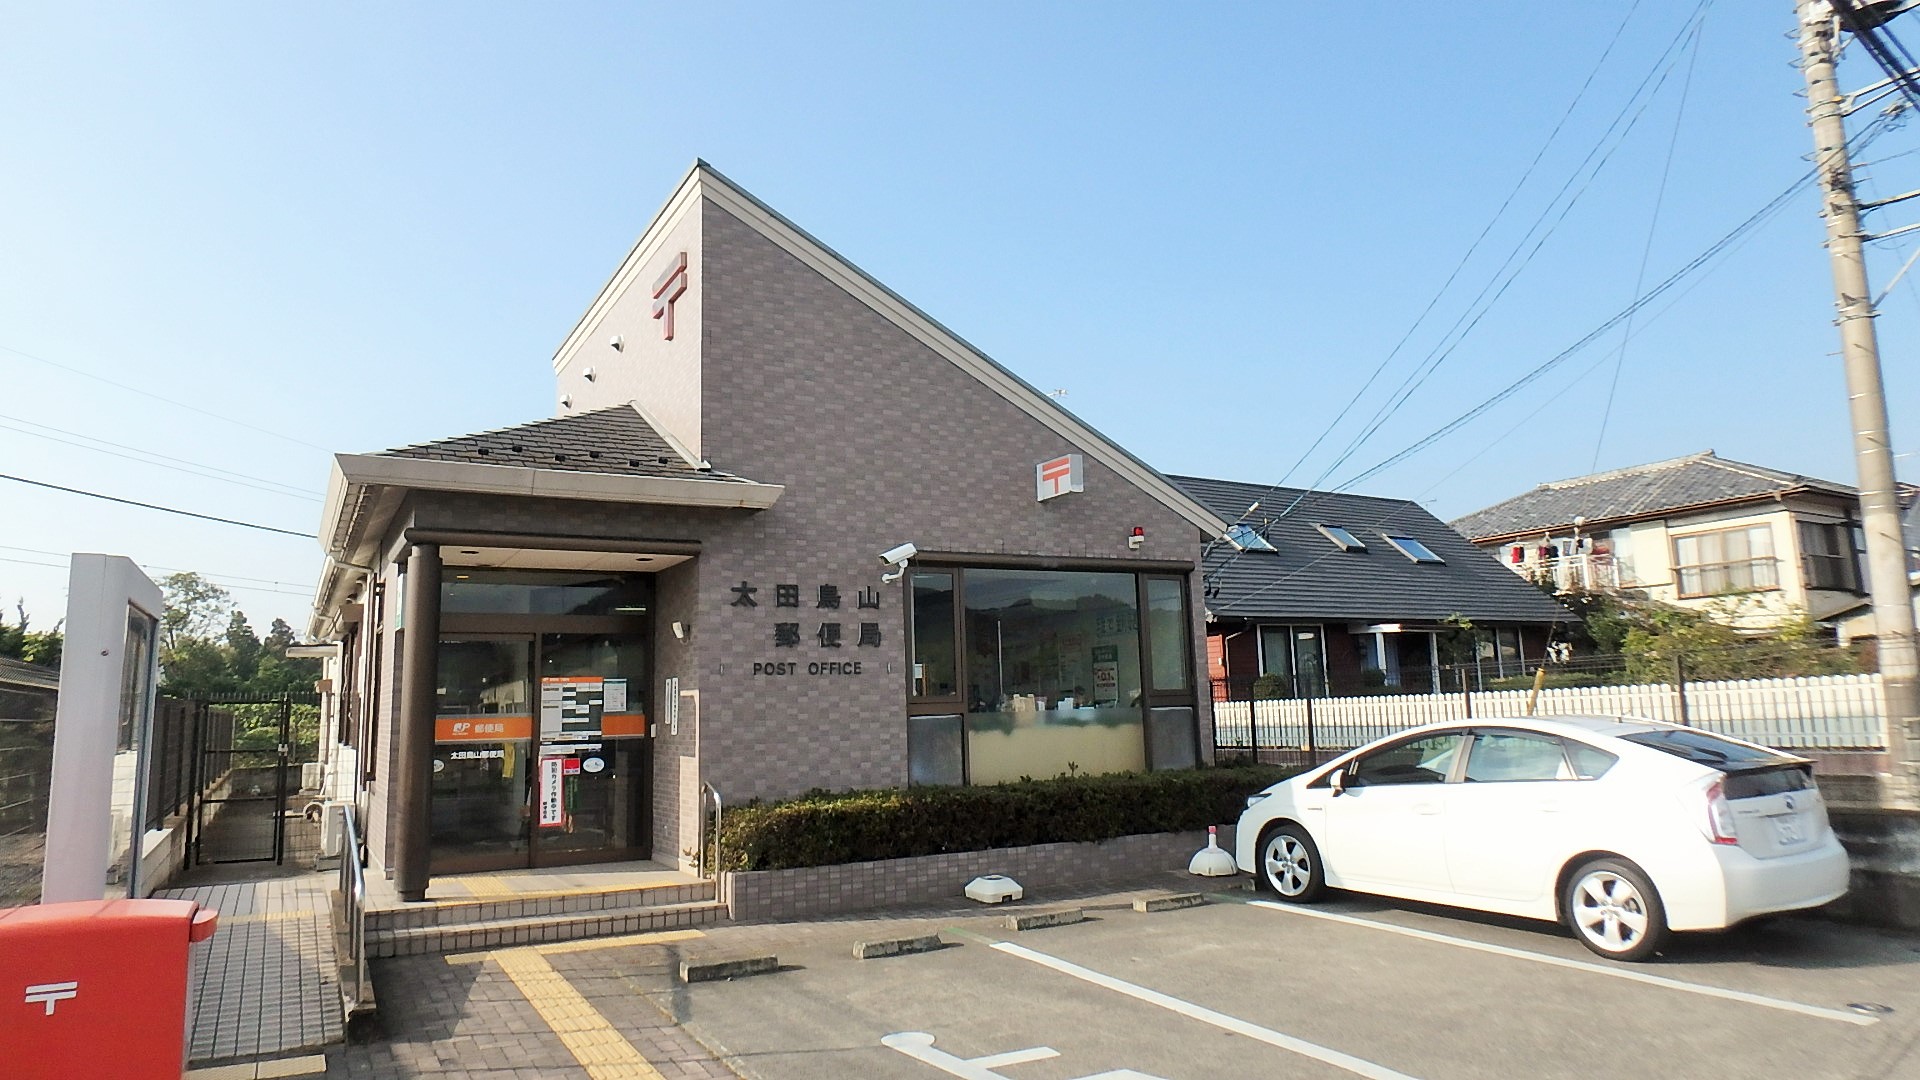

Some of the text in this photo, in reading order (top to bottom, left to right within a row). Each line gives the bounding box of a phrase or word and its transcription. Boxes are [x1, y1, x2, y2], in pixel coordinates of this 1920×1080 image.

[774, 622, 882, 648] 郵便局
[753, 661, 862, 676] POST OFFICE
[474, 723, 504, 733] 郵便局
